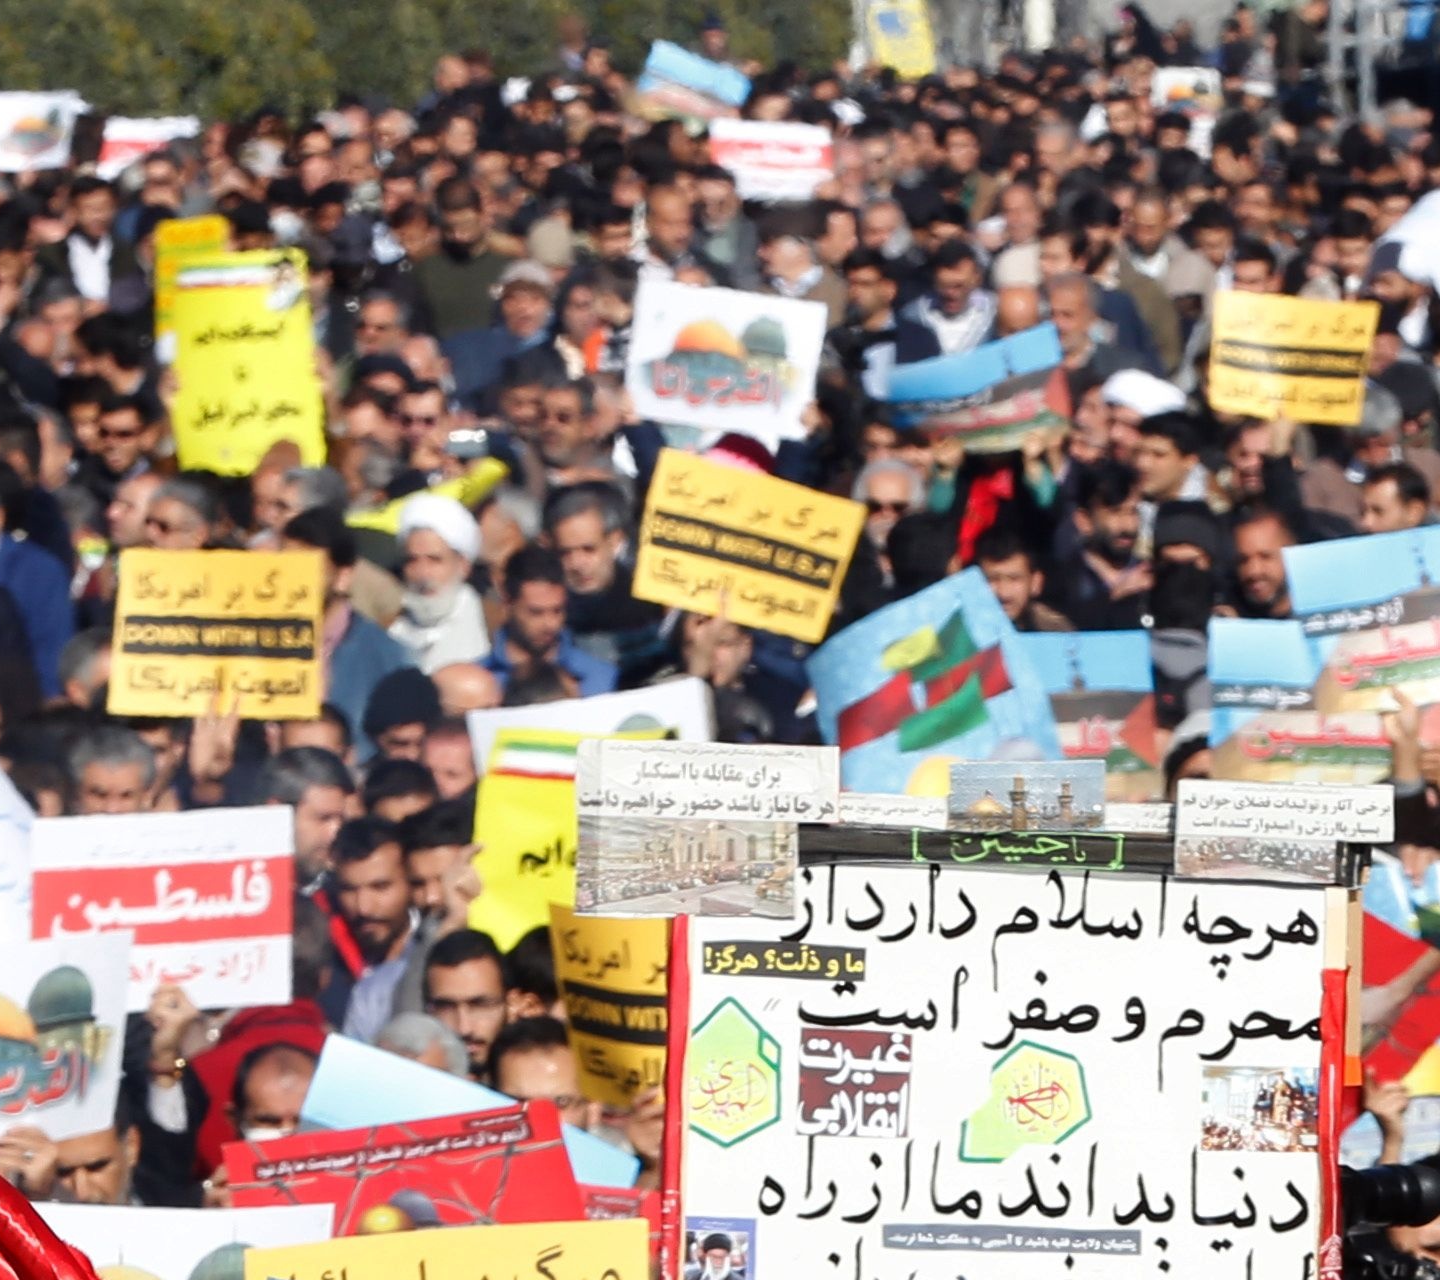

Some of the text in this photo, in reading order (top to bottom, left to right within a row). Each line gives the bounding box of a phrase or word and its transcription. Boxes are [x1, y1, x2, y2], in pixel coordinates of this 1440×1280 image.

[50, 861, 271, 940] فلسطین
[826, 958, 839, 975] و
[845, 953, 864, 972] ما
[1112, 997, 1147, 1041] و
[800, 1032, 912, 1085] غیرت
